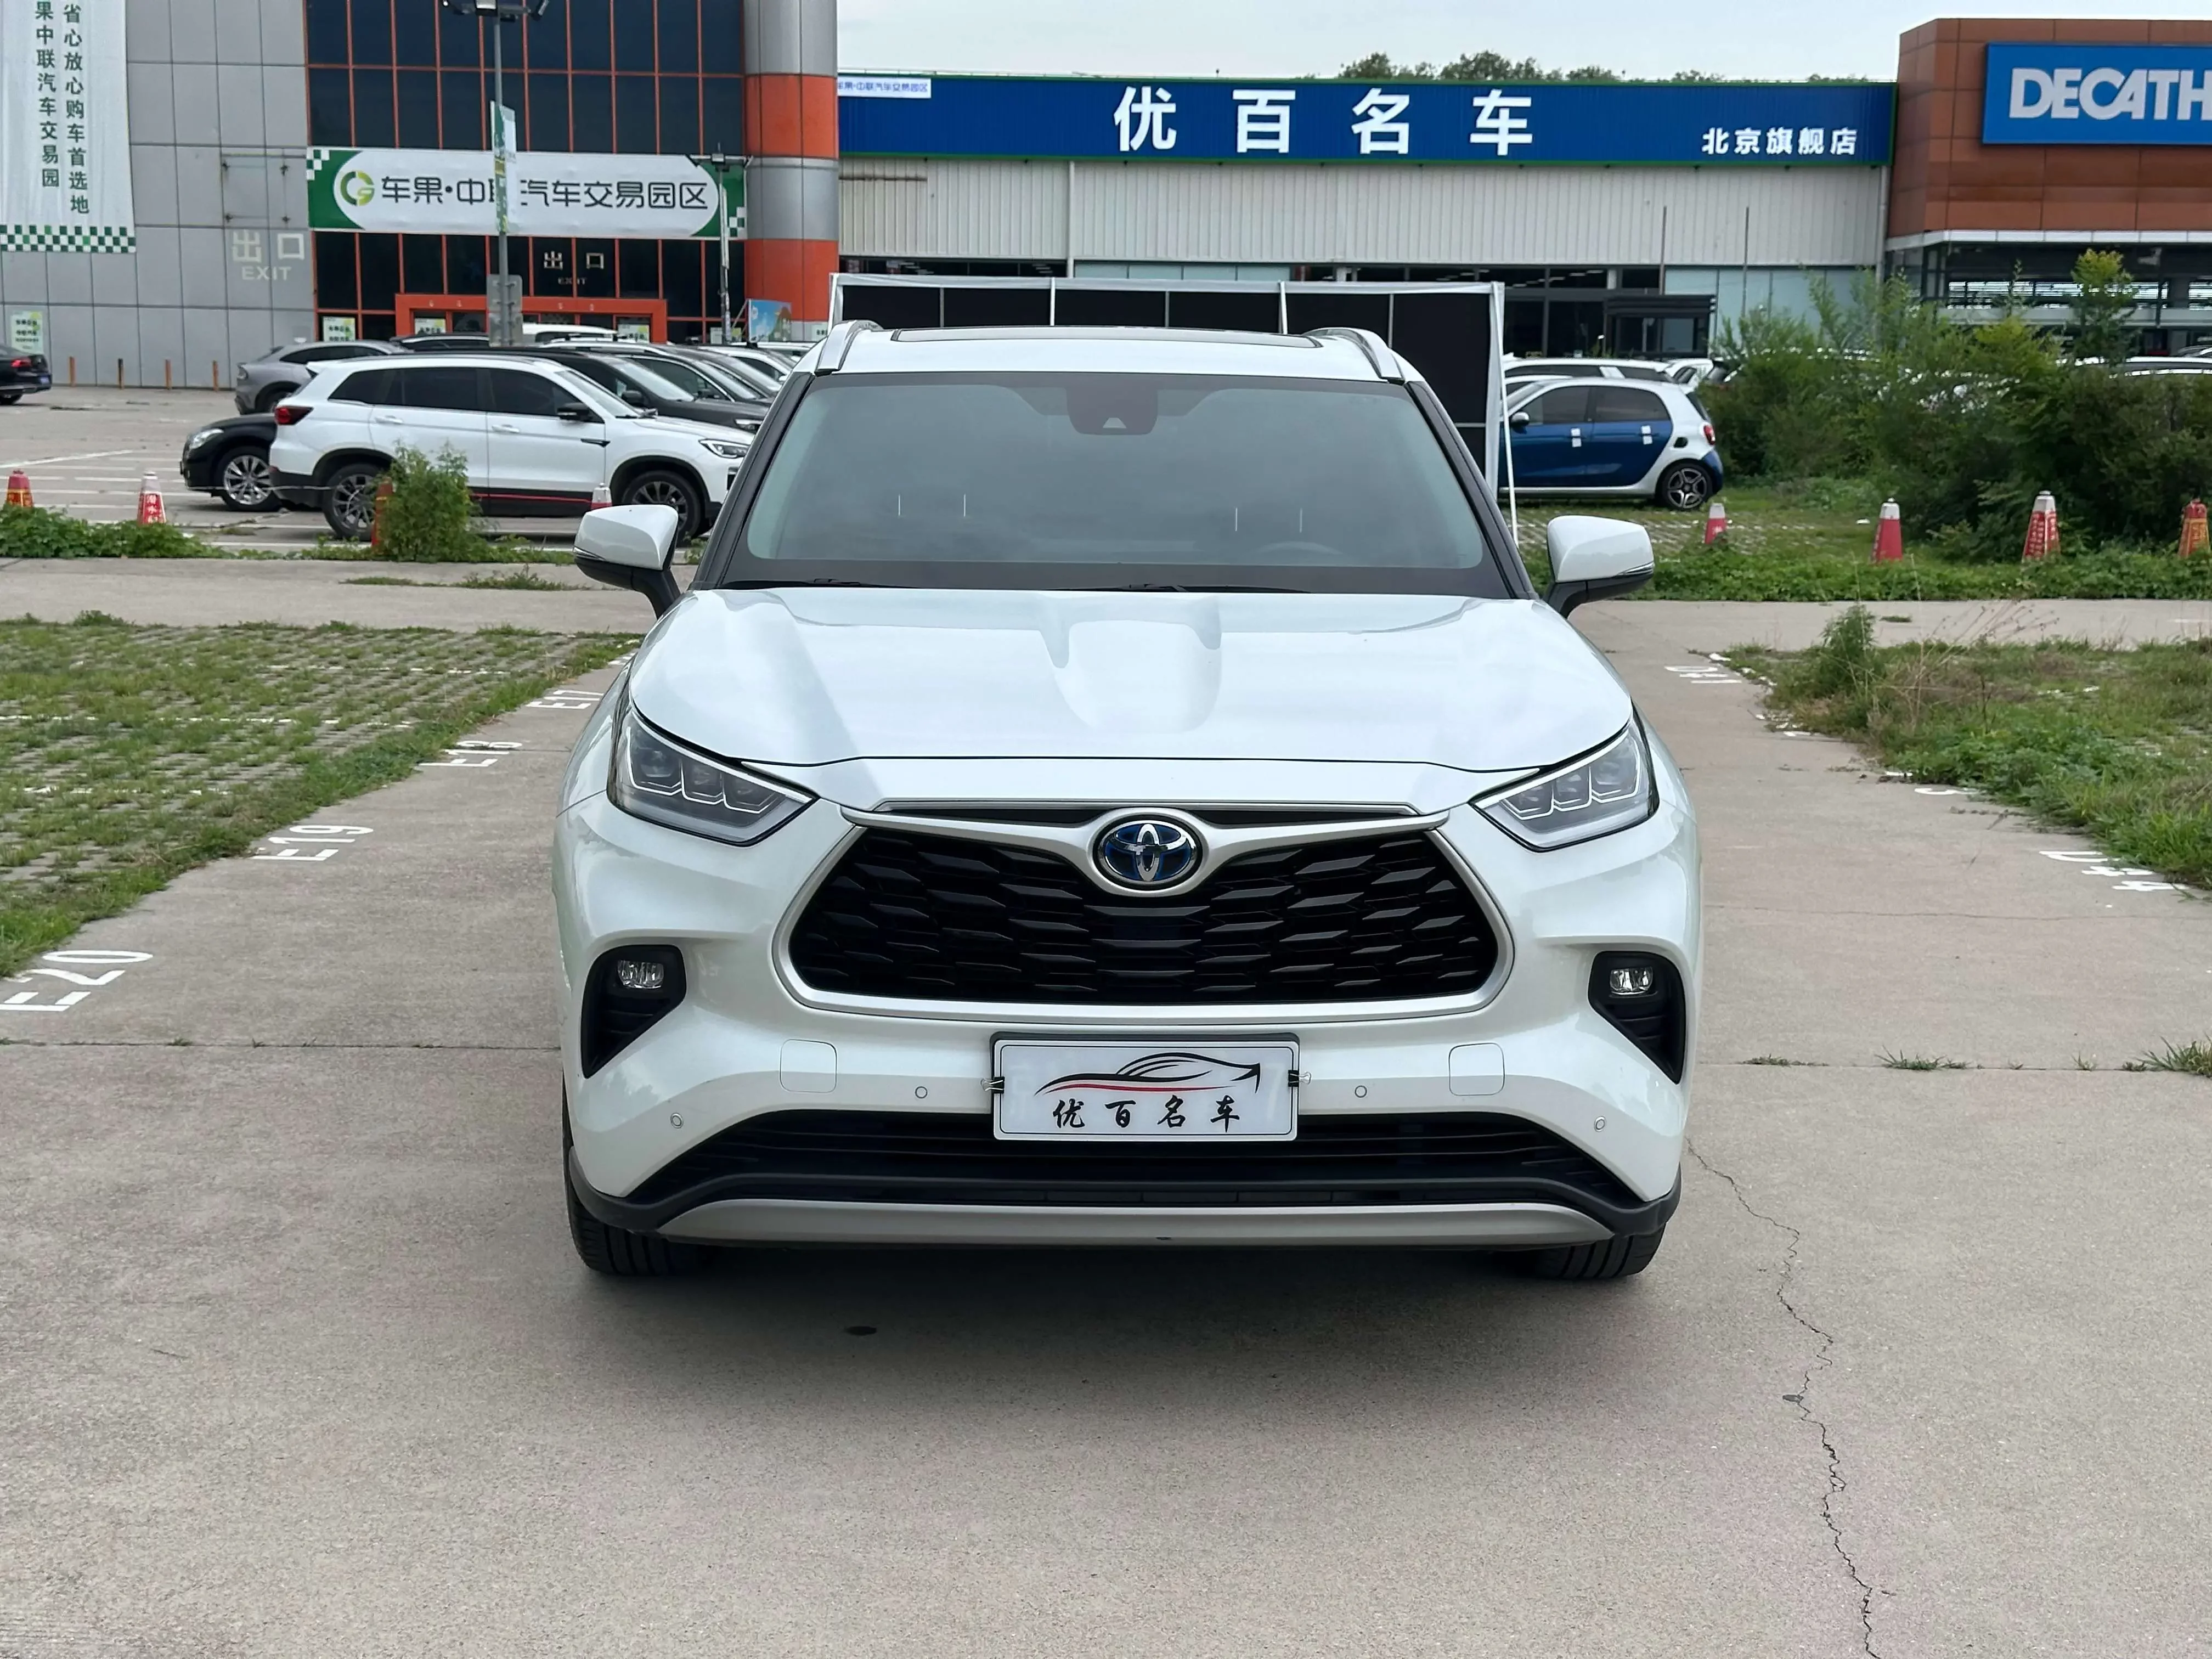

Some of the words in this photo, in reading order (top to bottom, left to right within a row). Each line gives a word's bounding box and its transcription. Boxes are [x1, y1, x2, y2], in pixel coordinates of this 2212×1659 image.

[63, 4, 89, 215] 省心放心购车首选地
[1113, 85, 1533, 156] 优百名车
[1701, 126, 1858, 156] 北京旗舰店
[232, 229, 306, 263] 出口
[544, 250, 605, 270] 出口
[241, 266, 292, 281] EXIT
[249, 825, 374, 861] E19
[1052, 1094, 1240, 1133] 优百名车
